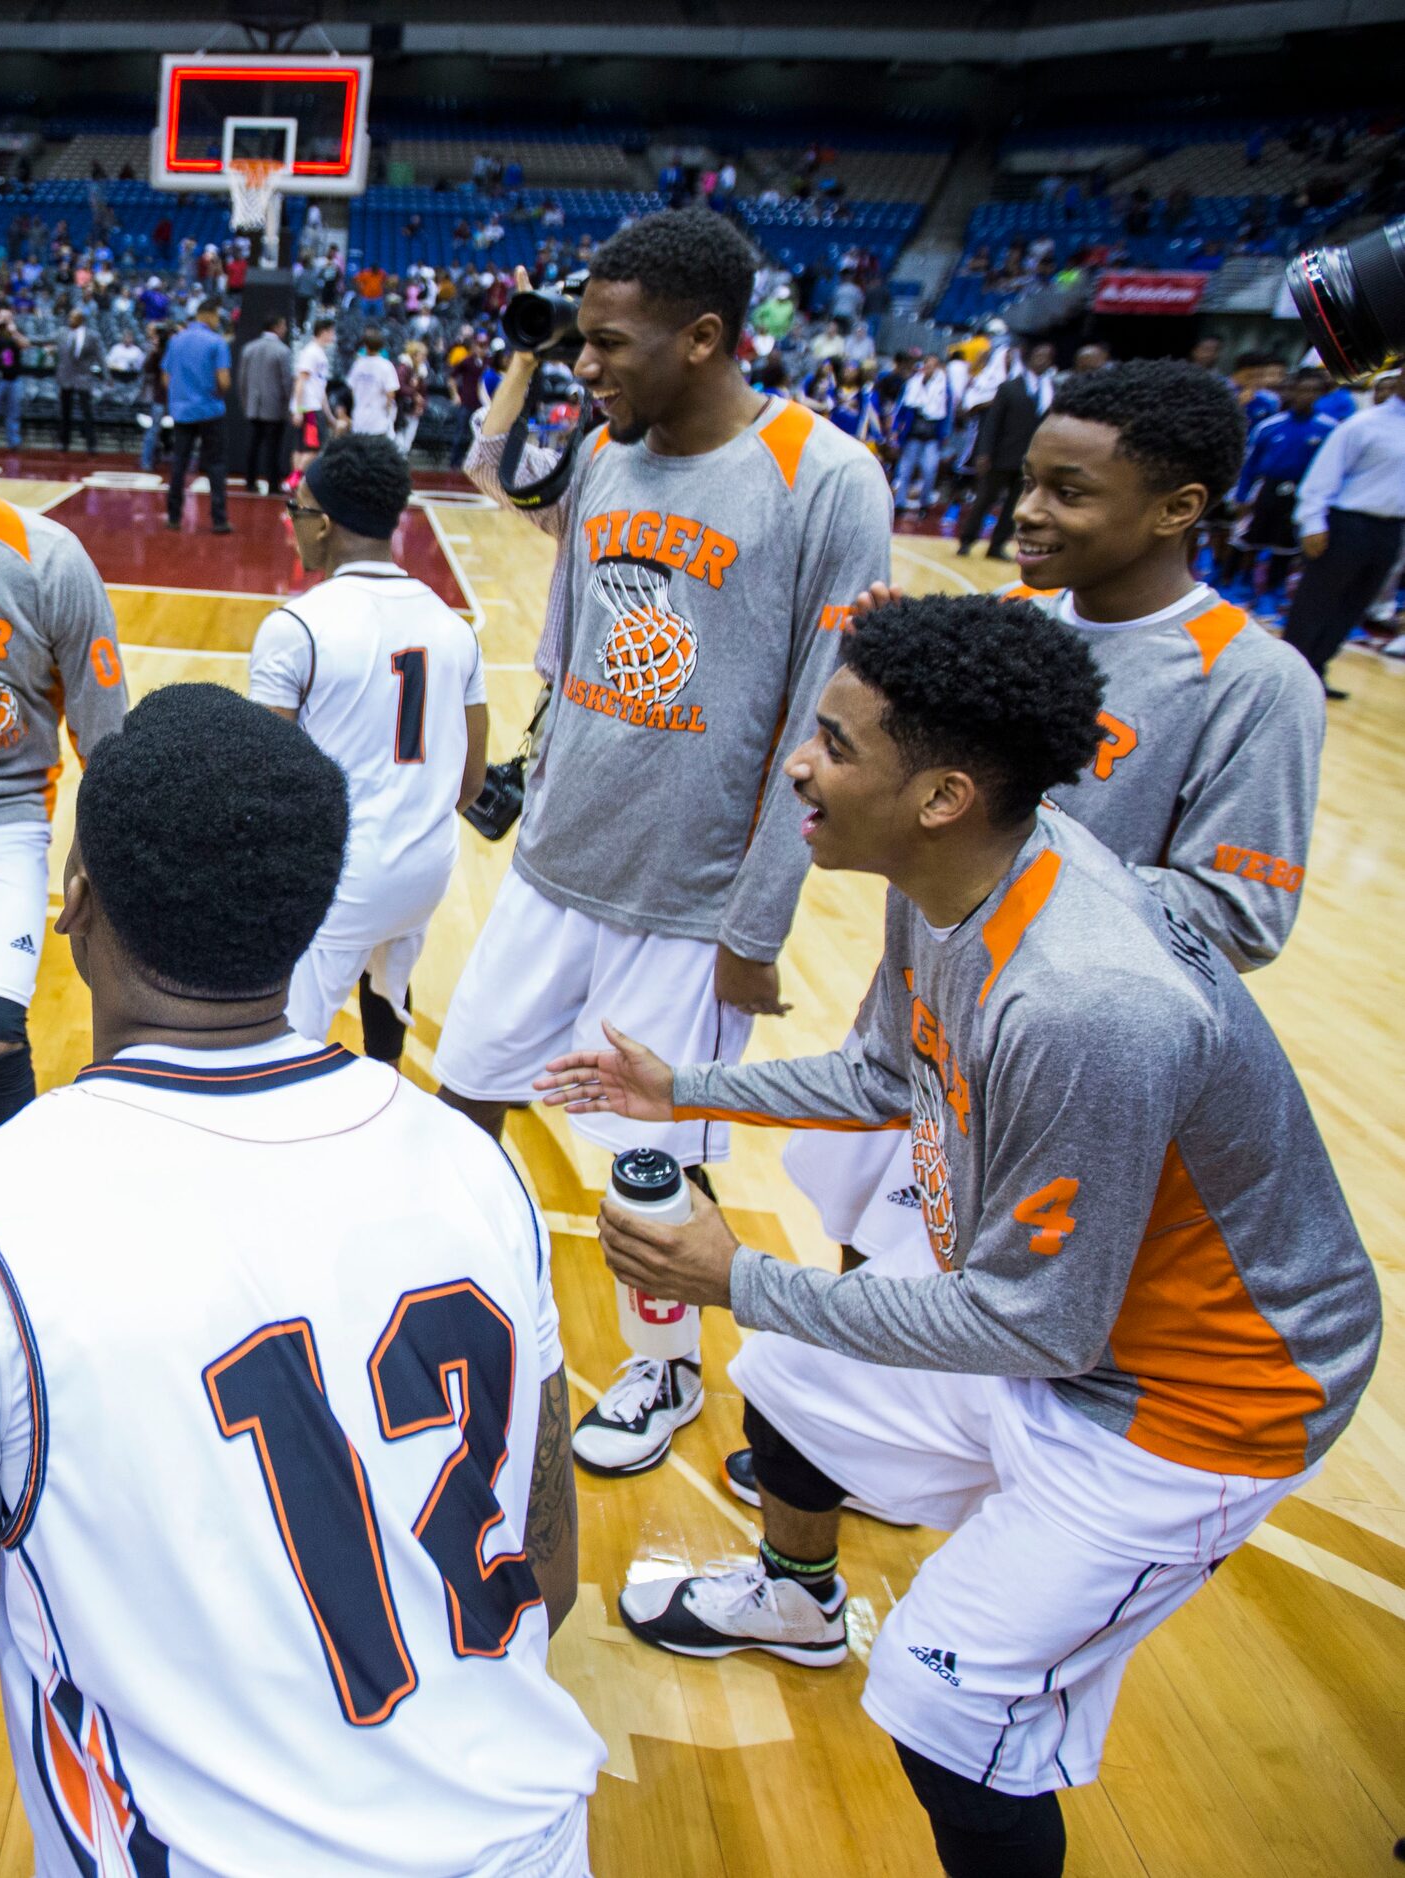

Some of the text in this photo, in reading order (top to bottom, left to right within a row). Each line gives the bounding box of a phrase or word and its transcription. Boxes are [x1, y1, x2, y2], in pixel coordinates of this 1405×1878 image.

[583, 509, 739, 591] TIGER
[391, 646, 427, 764] 1
[1013, 1176, 1080, 1256] 4
[201, 1277, 544, 1726] 12
[907, 1645, 962, 1688] adidas
